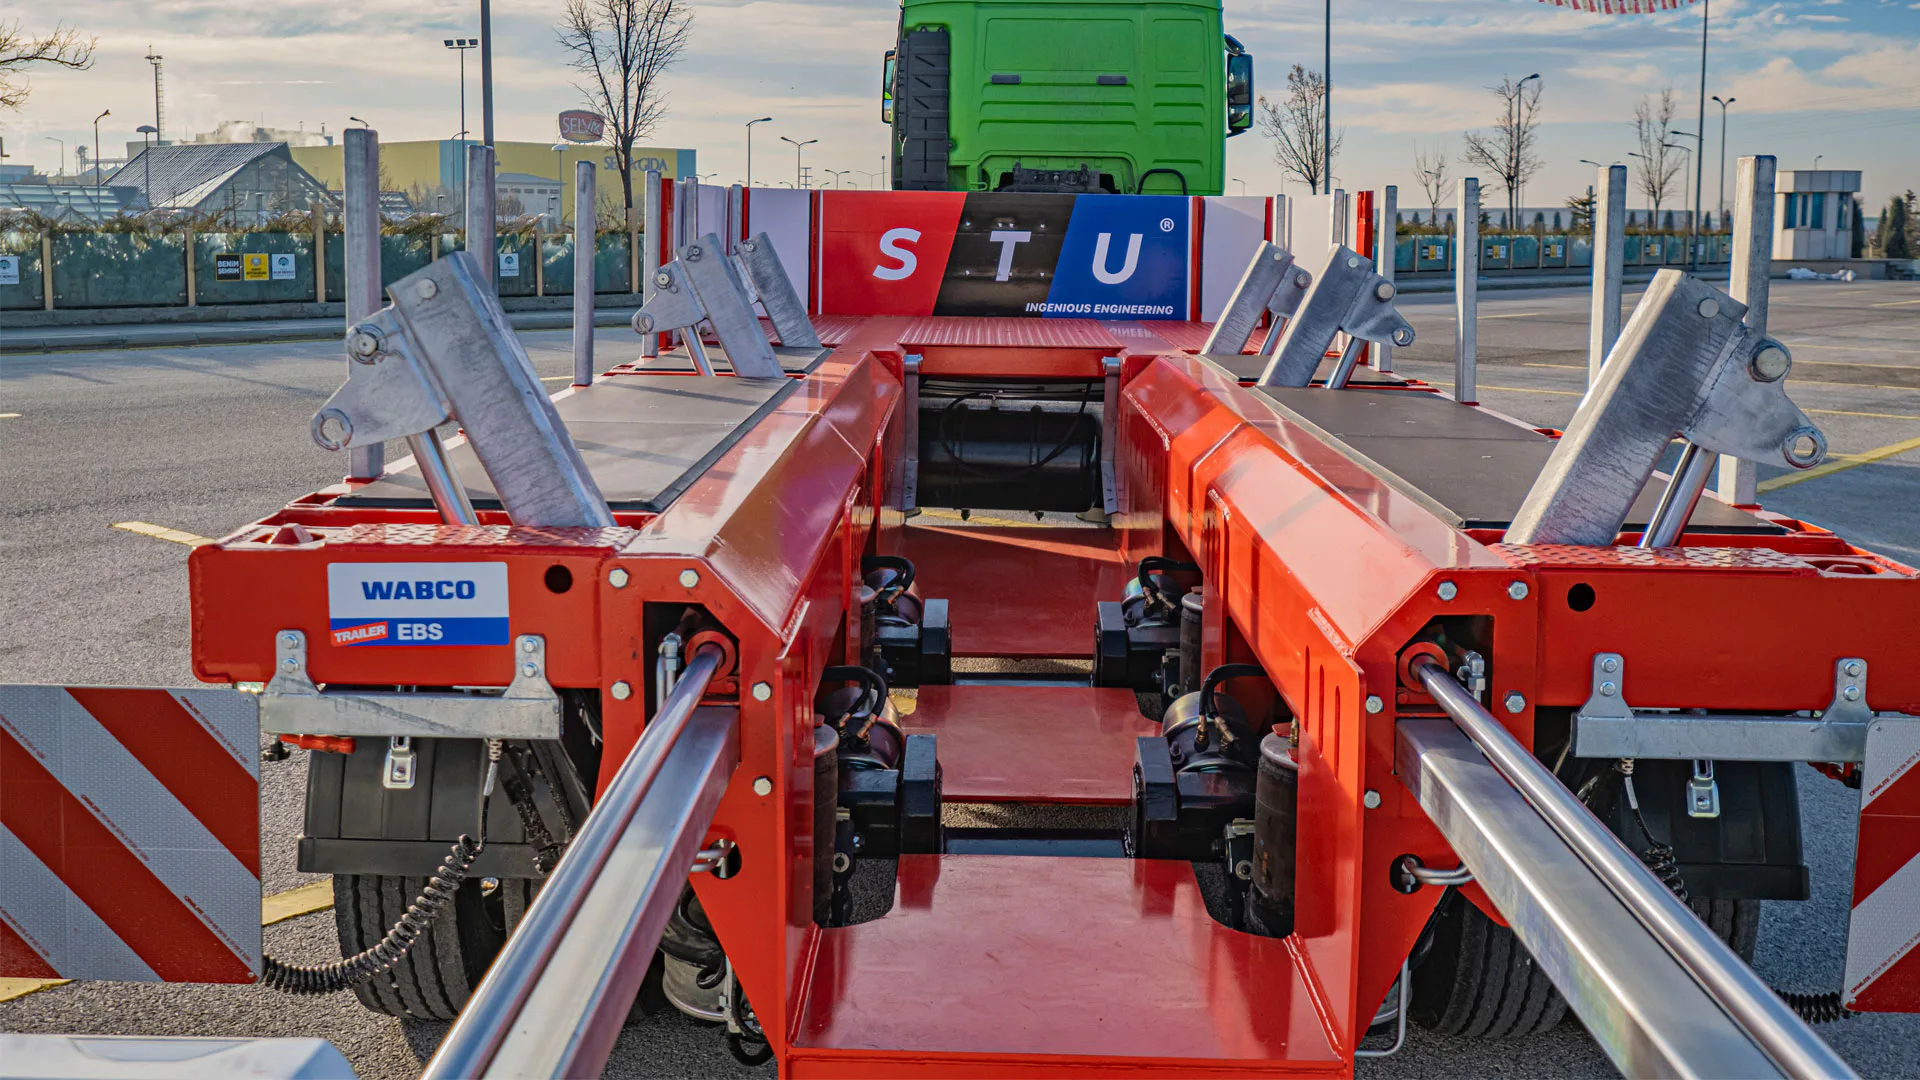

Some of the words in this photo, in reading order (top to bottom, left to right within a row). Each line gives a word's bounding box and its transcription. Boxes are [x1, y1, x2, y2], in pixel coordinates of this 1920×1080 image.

[1025, 302, 1092, 314] INGENIOUS
[1093, 303, 1174, 315] ENGINEERING
[361, 580, 476, 601] WABCO
[334, 624, 387, 643] TRAILER
[397, 622, 444, 641] EBS
